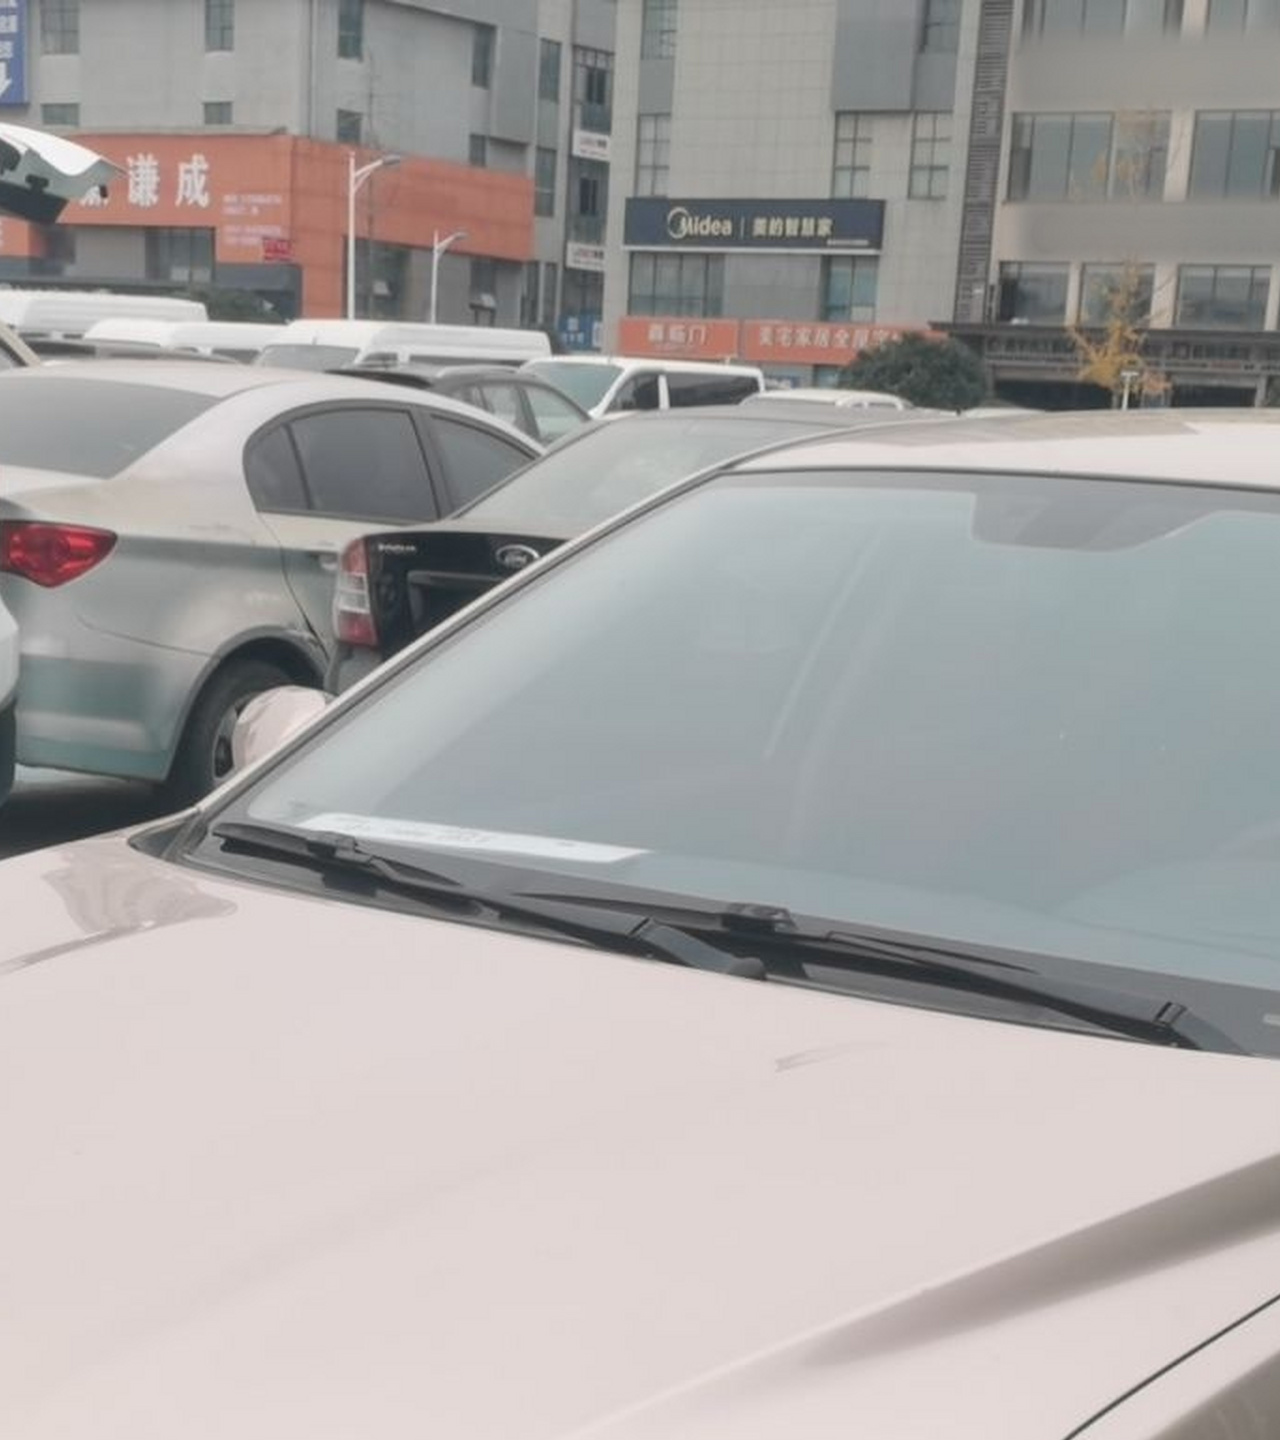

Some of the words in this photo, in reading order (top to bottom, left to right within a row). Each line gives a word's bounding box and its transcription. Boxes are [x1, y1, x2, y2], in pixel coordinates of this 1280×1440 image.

[668, 207, 733, 239] Midea
[752, 217, 834, 237] 美的智慧家
